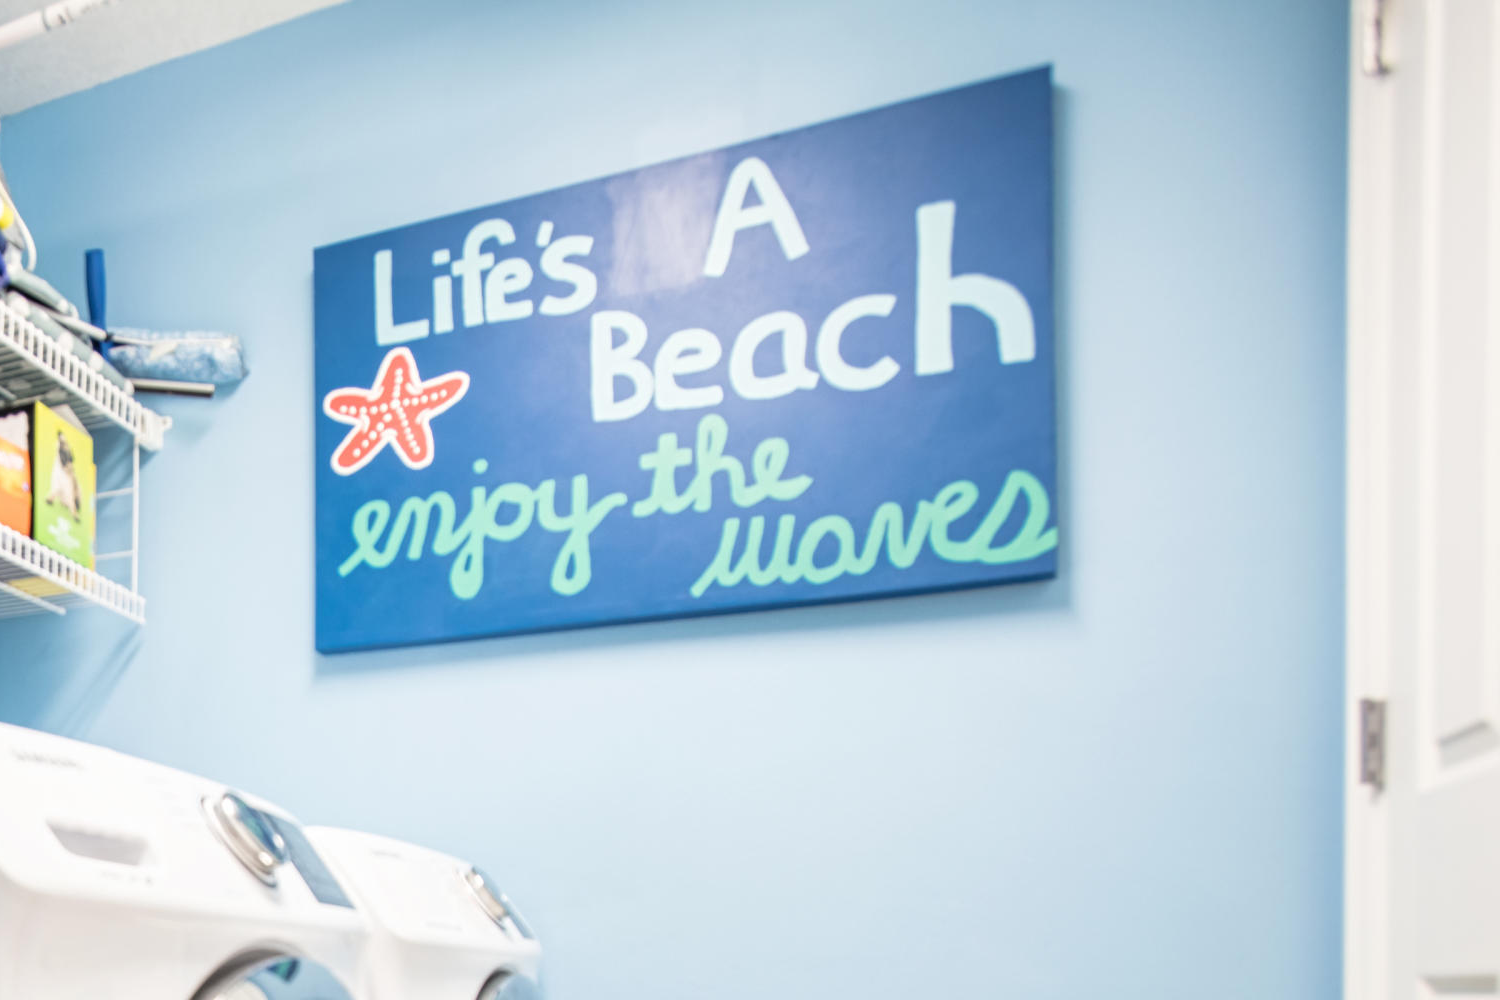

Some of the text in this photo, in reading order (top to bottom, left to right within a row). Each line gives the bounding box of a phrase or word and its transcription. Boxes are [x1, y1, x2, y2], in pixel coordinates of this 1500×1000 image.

[374, 157, 810, 346] Life's A
[591, 200, 1036, 423] Beach
[338, 414, 813, 599] enjoy the
[690, 469, 1060, 597] waves
